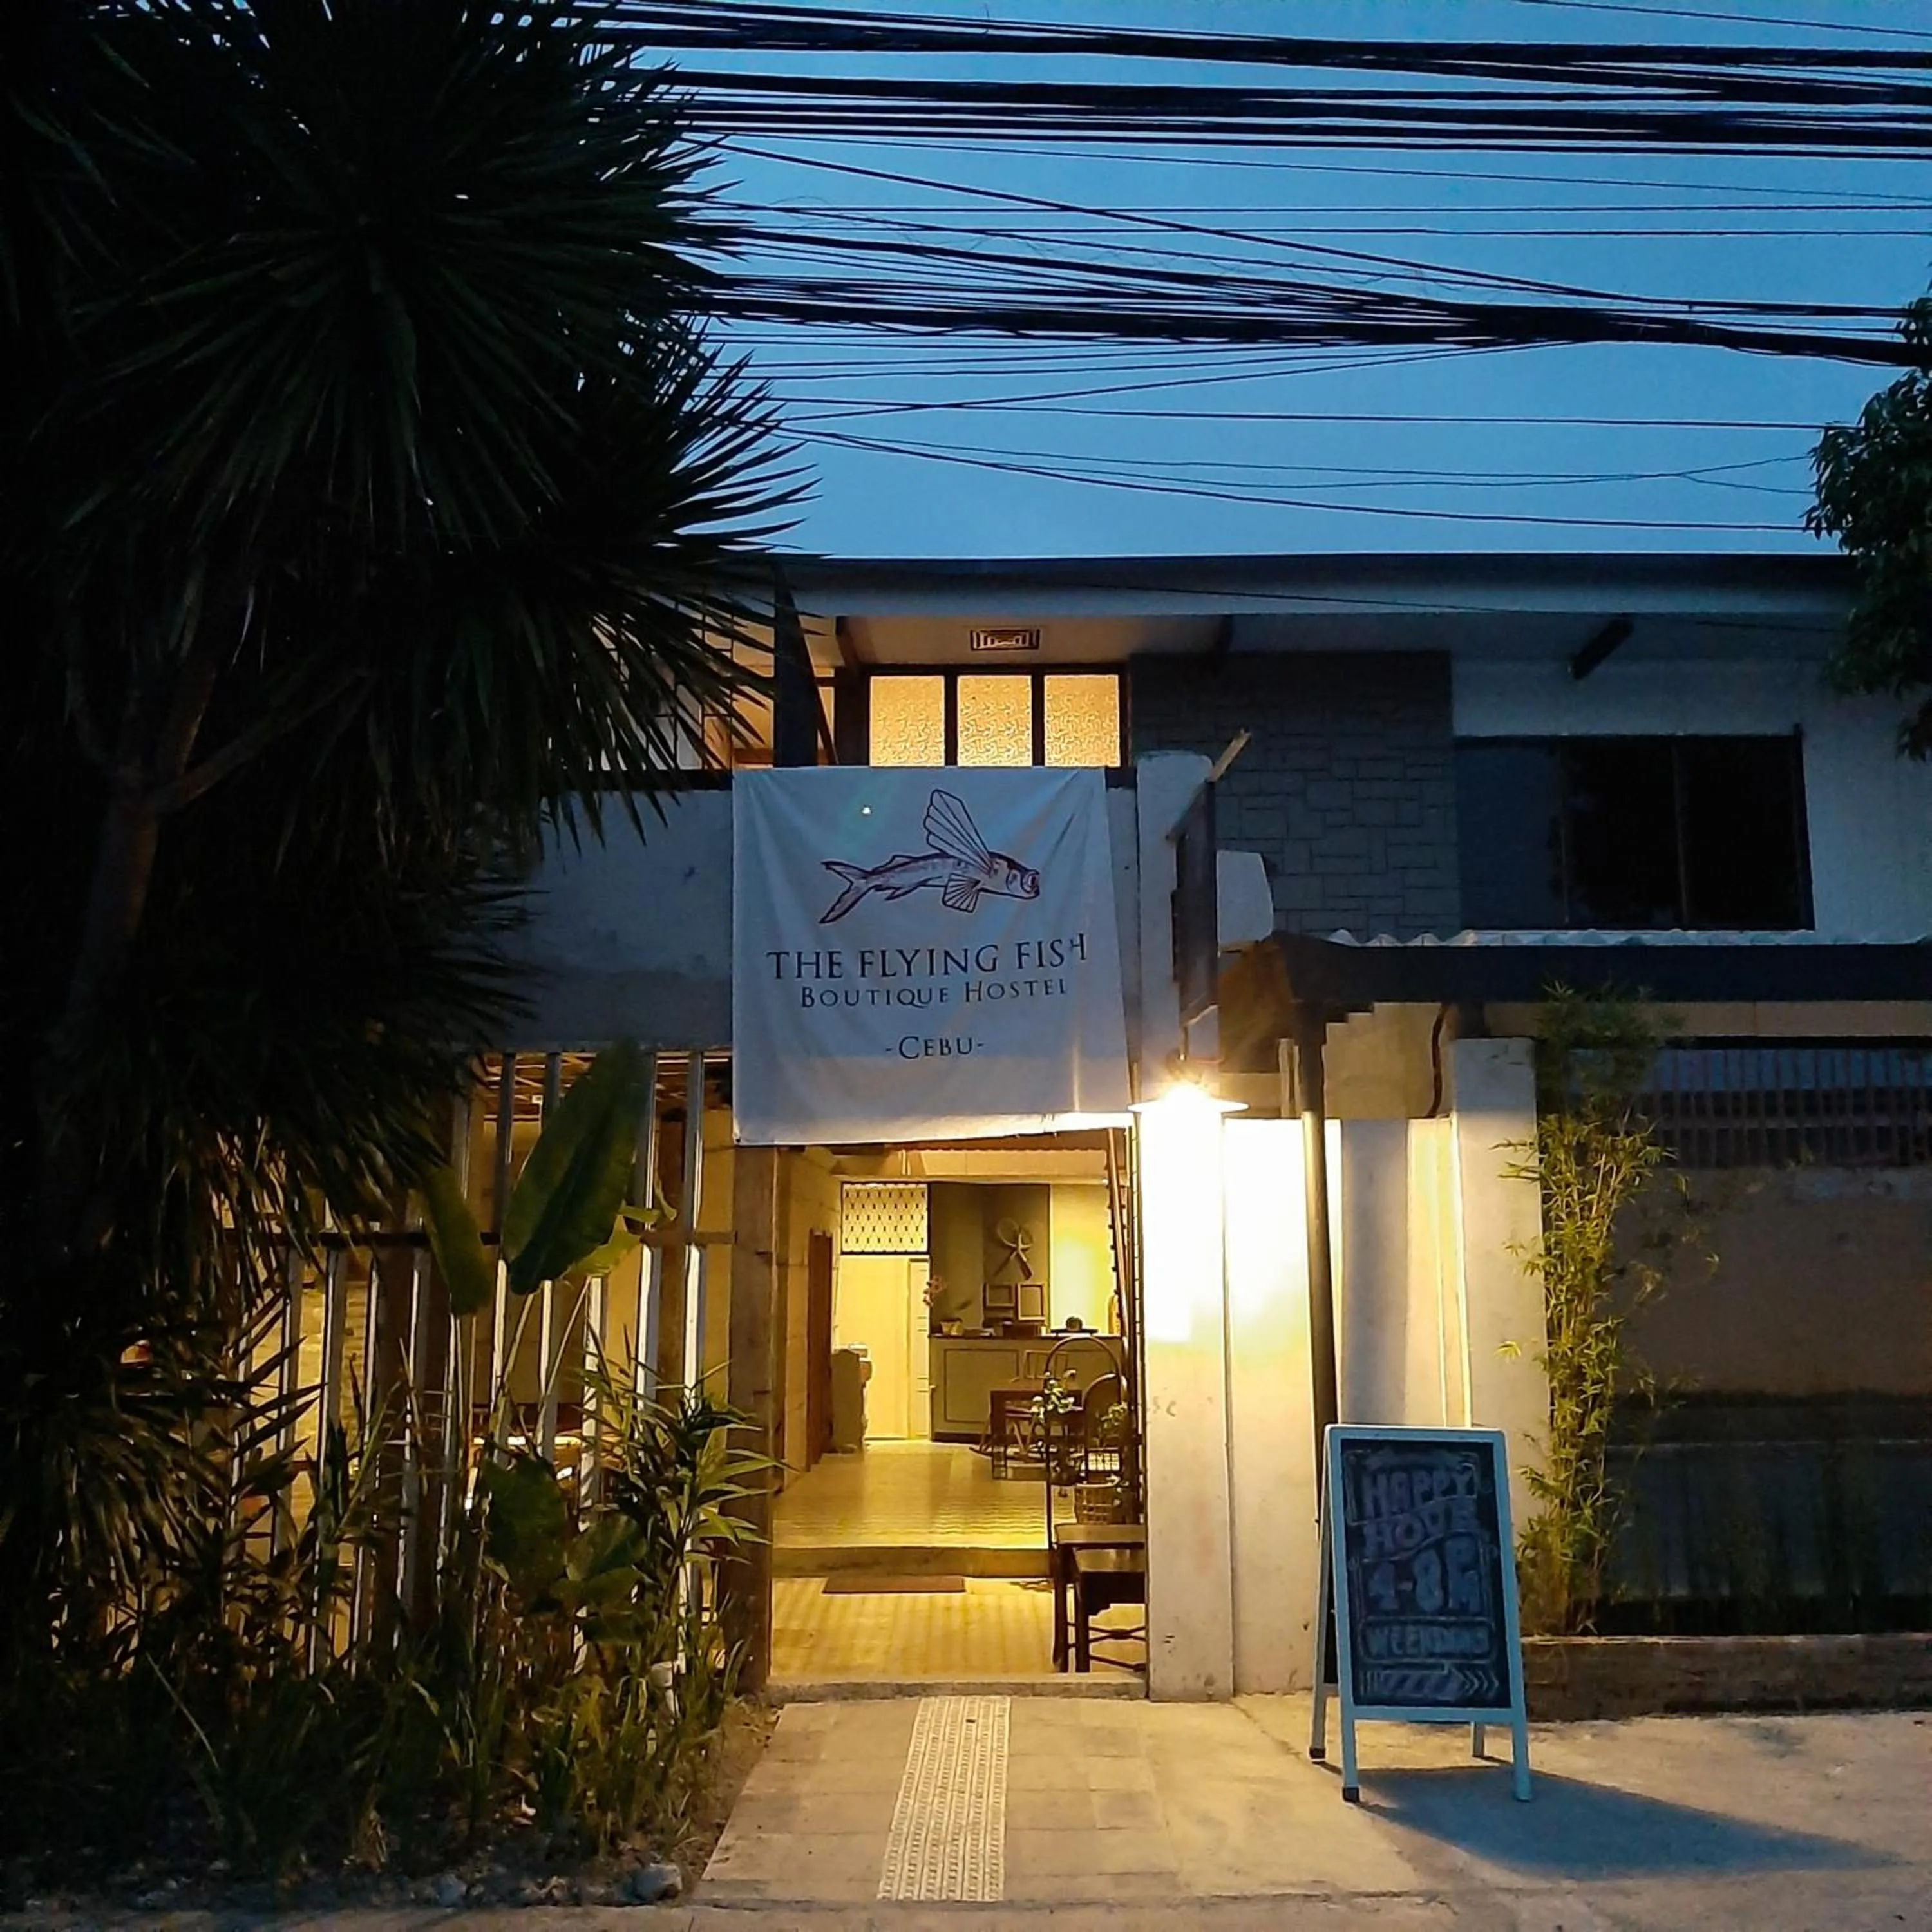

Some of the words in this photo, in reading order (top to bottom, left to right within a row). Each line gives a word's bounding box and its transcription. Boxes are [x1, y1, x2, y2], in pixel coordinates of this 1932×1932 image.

[767, 951, 843, 979] THE
[859, 945, 999, 978] FLYING
[1016, 933, 1087, 969] FISH
[802, 980, 949, 1008] BOUTIQUE
[965, 978, 1067, 1003] HOSTEL
